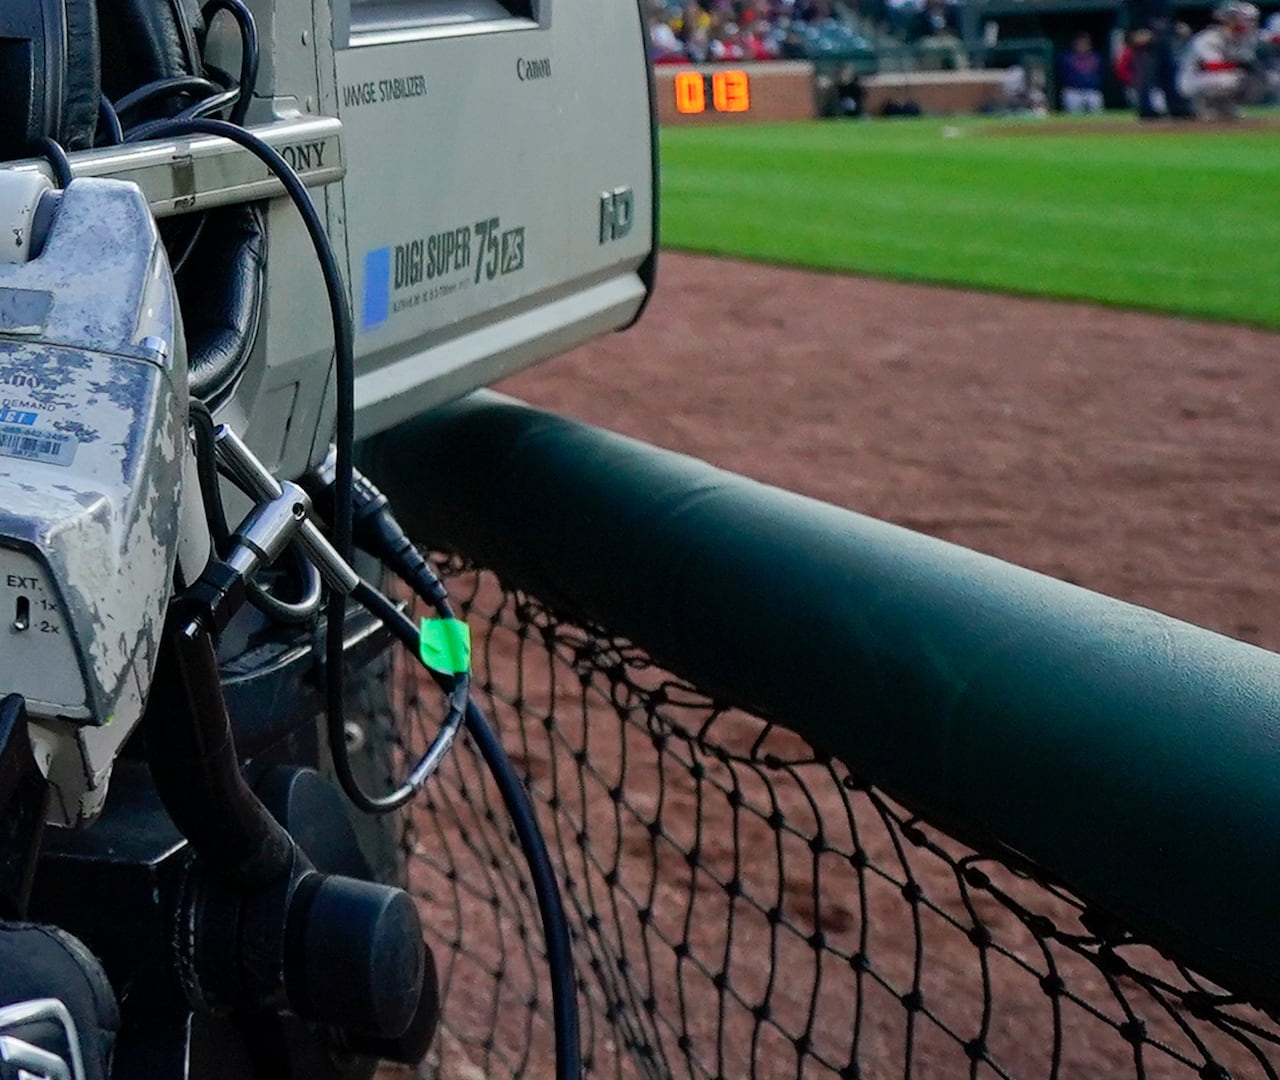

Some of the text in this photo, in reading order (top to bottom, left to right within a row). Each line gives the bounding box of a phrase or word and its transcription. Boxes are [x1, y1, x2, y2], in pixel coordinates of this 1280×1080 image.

[516, 57, 552, 82] Canon
[343, 75, 428, 107] IMAGE STABILIZER
[599, 185, 634, 245] HD
[394, 216, 500, 290] DIGI SUPER 75
[2, 398, 56, 412] DEMAND
